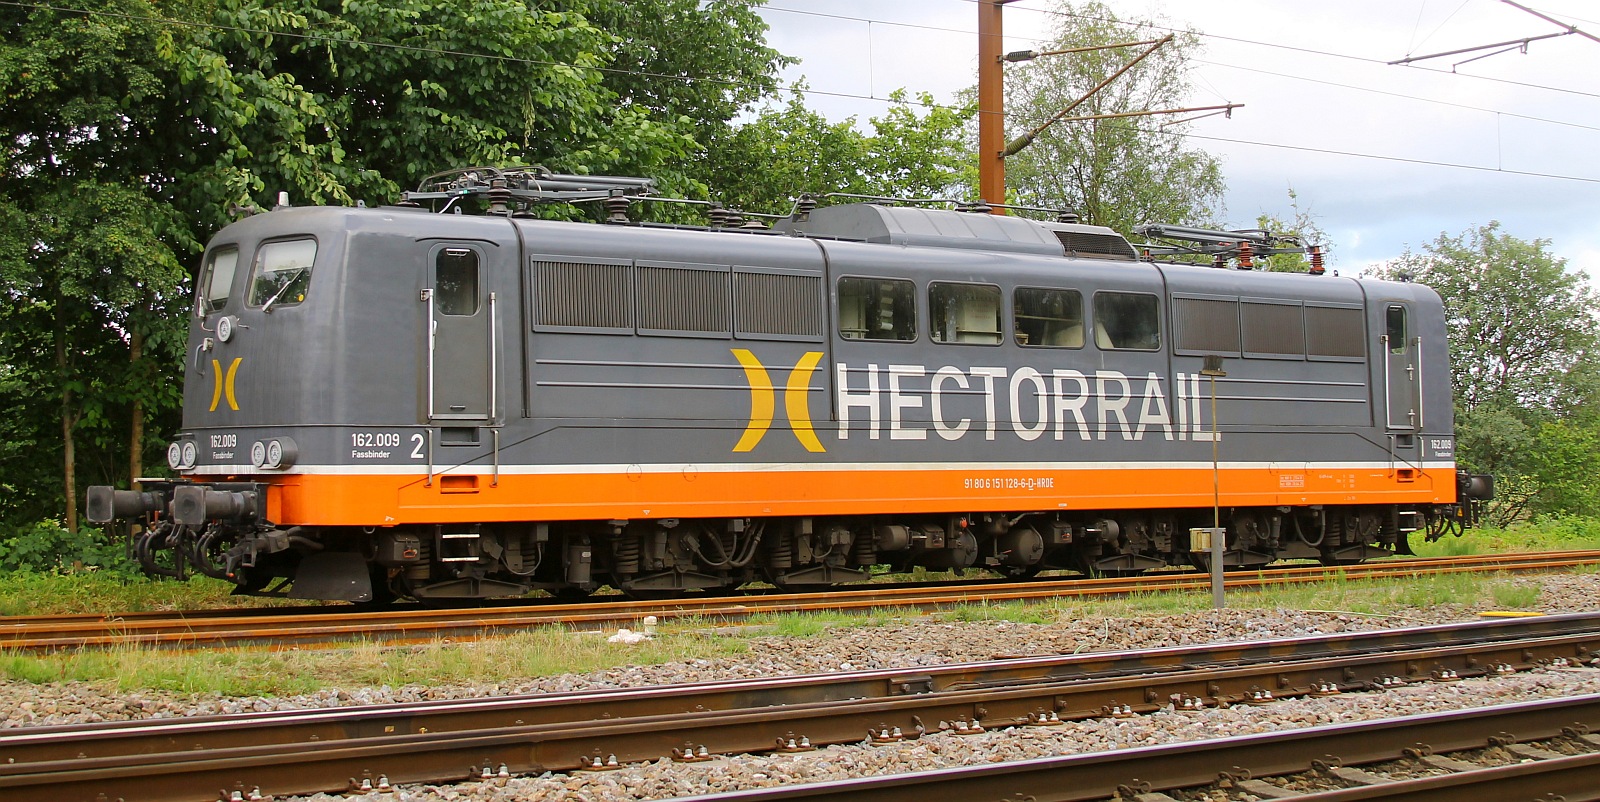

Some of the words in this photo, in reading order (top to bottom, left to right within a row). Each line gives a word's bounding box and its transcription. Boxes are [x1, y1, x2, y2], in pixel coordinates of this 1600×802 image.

[836, 362, 1222, 442] HECTORRAIL
[210, 434, 237, 448] 162.009
[351, 433, 400, 447] 162.009
[410, 433, 424, 459] 2
[351, 450, 391, 458] Fassbinder
[964, 478, 973, 489] 91
[974, 478, 985, 489] 80
[985, 478, 991, 489] 6
